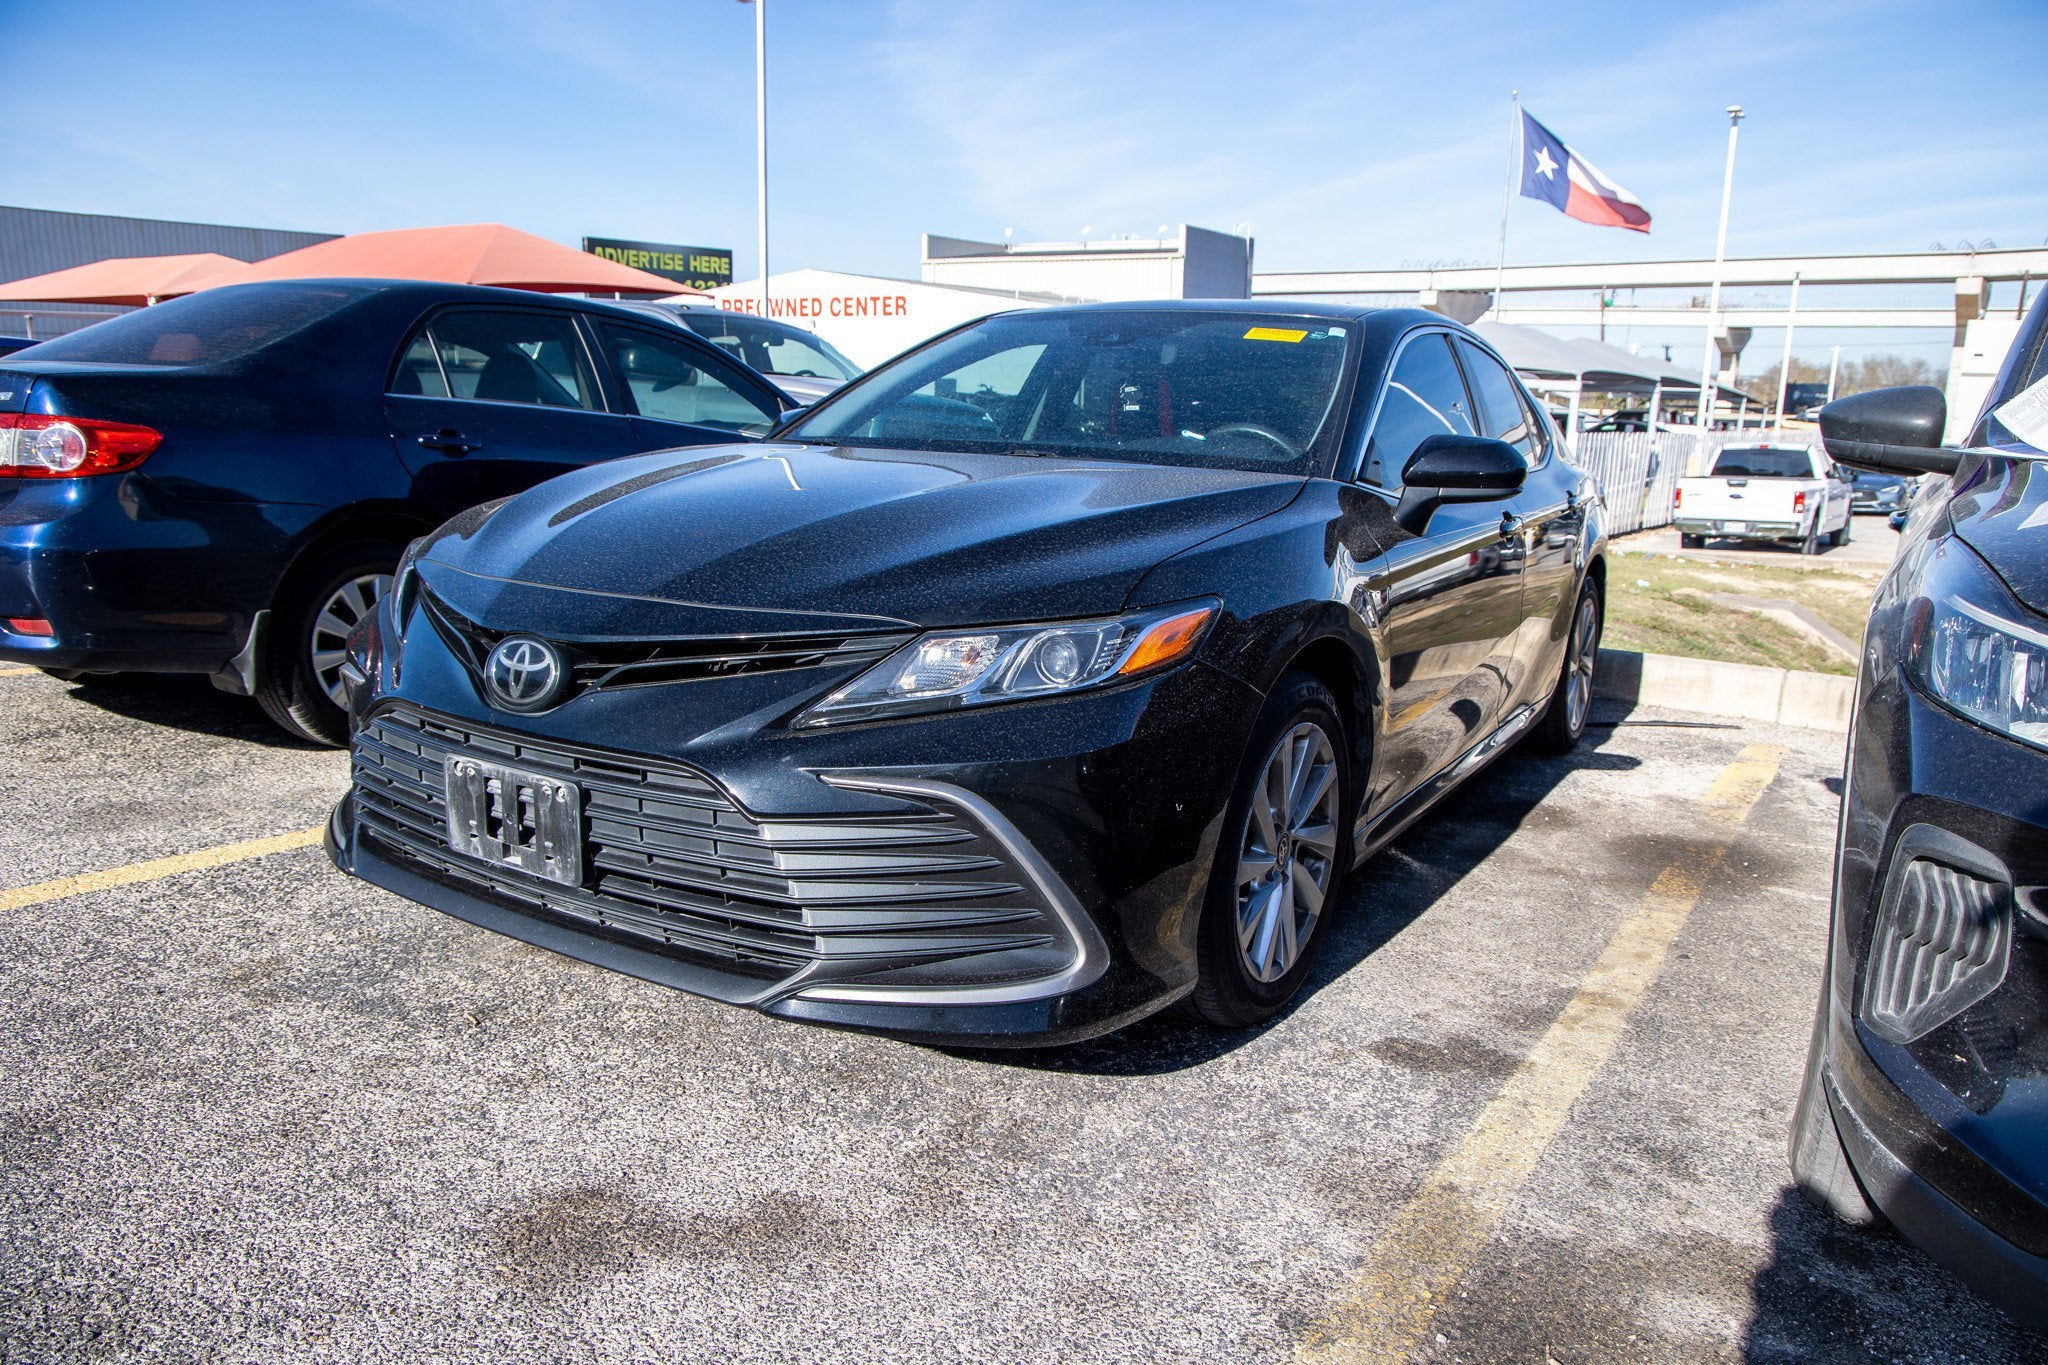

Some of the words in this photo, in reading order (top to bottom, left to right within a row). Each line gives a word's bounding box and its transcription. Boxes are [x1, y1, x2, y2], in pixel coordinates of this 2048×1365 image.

[594, 246, 684, 272] ADVERTISE
[689, 254, 730, 275] HERE
[829, 296, 907, 317] CENTER
